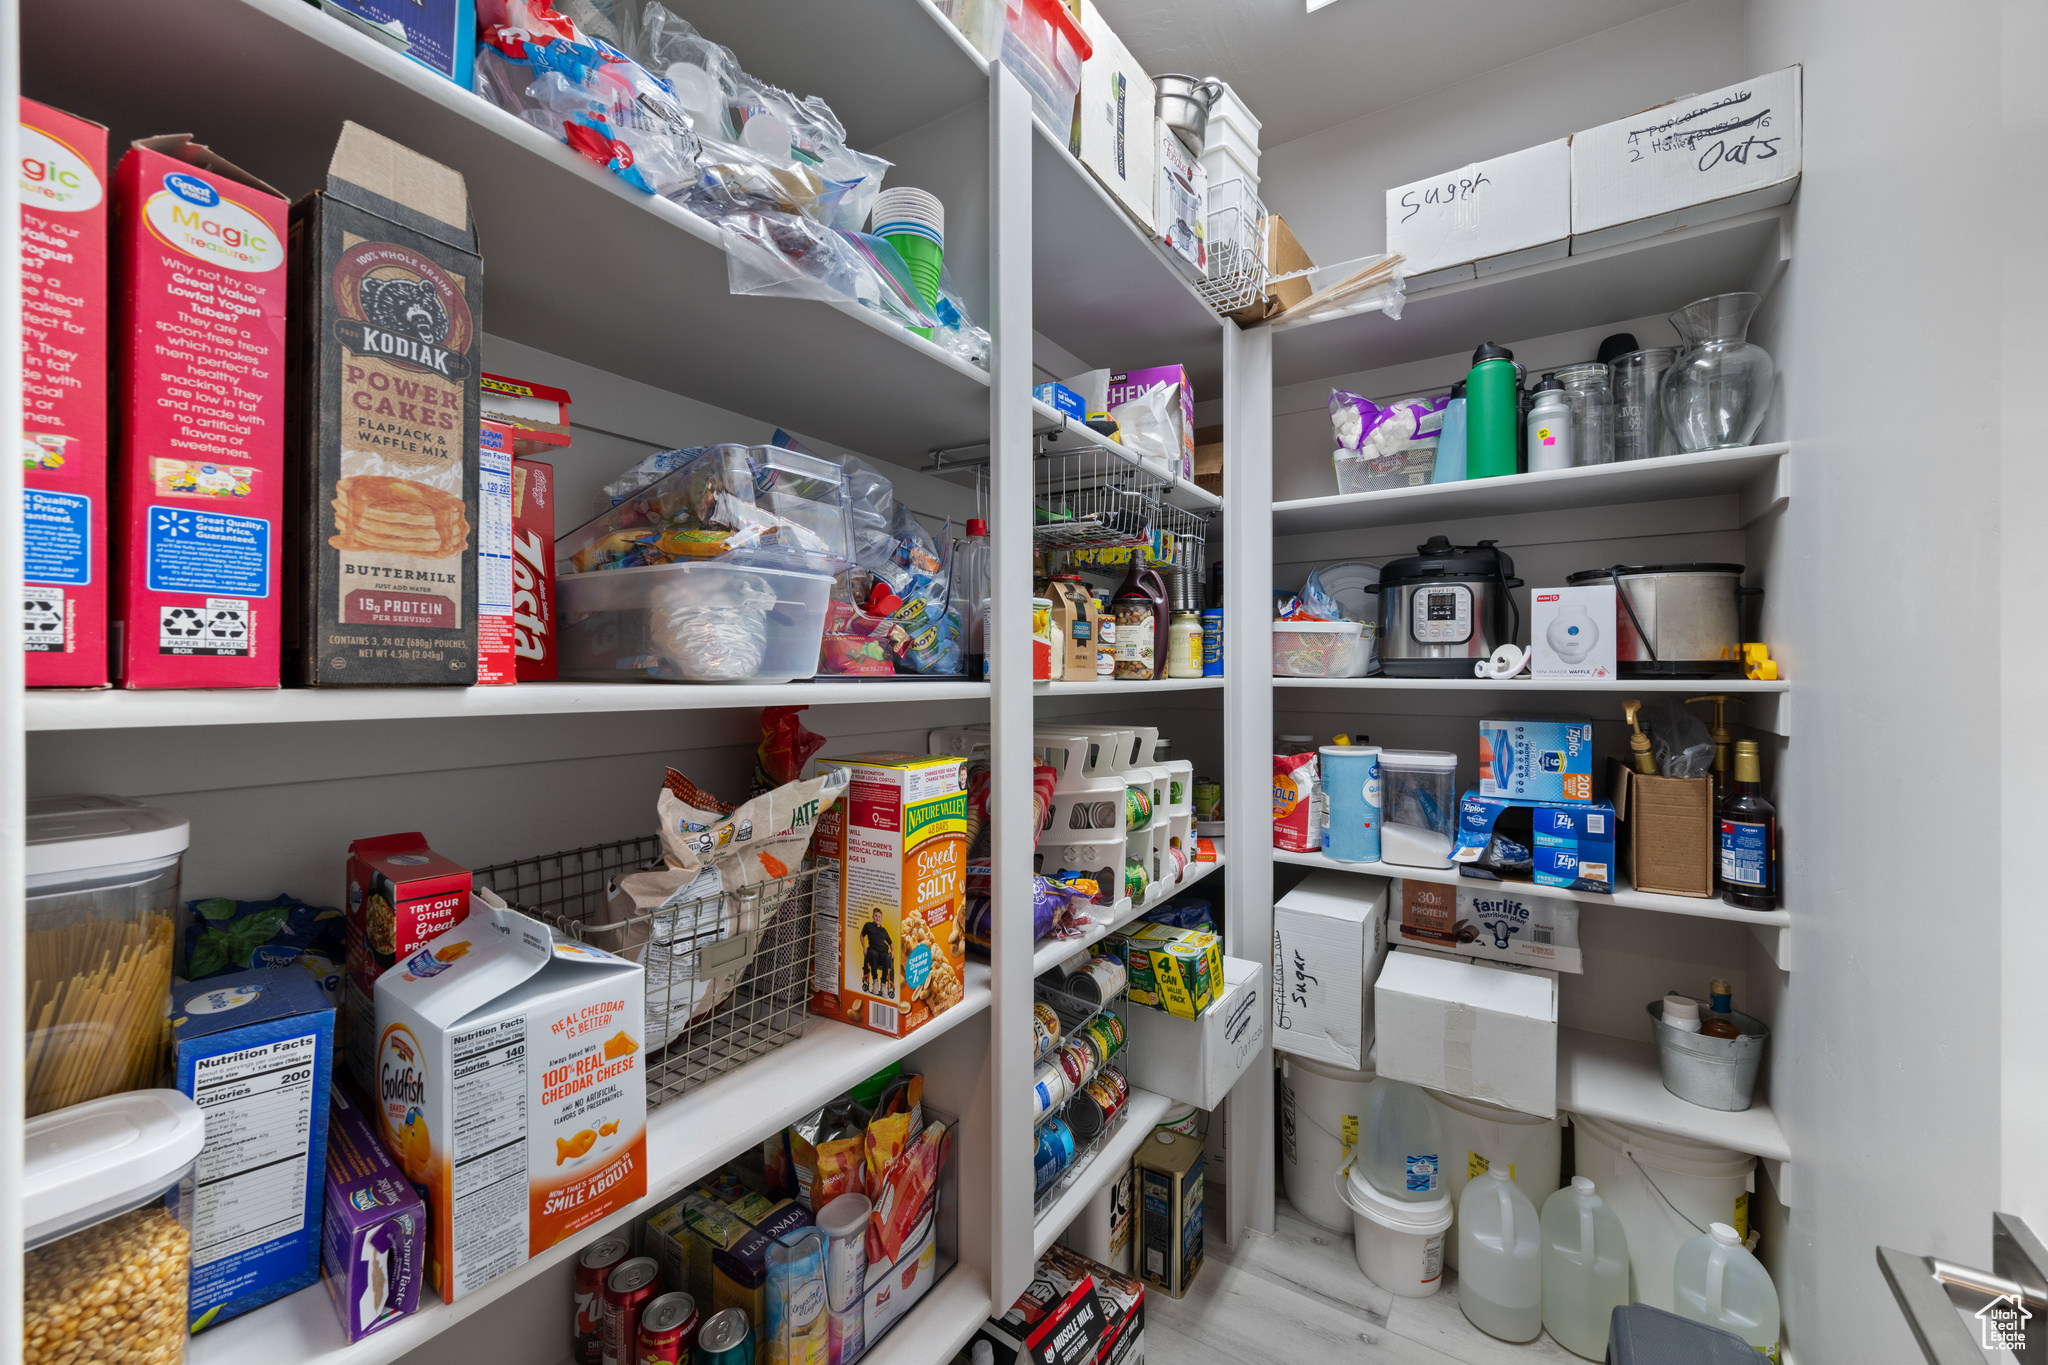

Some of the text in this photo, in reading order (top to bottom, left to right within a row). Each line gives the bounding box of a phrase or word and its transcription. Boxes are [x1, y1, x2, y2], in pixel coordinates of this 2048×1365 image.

[408, 27, 441, 49] CUTLERY
[1163, 138, 1187, 175] Fondue
[1628, 149, 1644, 163] 2
[1698, 135, 1782, 172] Oats
[22, 157, 81, 189] gic
[170, 176, 211, 199] Great
[24, 213, 80, 238] try our
[172, 204, 268, 253] Magic
[161, 256, 194, 274] Why
[356, 250, 454, 297] 100% WHOLE GRAINS
[43, 288, 85, 308] treat
[172, 272, 257, 304] Great Value
[167, 283, 262, 318] Lowfat Yogurt
[177, 310, 211, 330] They
[190, 302, 239, 324] Tubes?
[156, 320, 269, 355] spoon-free treat
[38, 342, 78, 362] They
[154, 344, 249, 374] them perfect
[167, 336, 260, 365] which makes
[362, 326, 450, 375] KODIAK
[188, 364, 240, 386] healthy
[160, 372, 263, 403] snacking. They
[196, 391, 221, 405] low
[346, 364, 459, 411] POWER
[157, 398, 235, 420] and made
[352, 391, 457, 430] CAKES
[181, 426, 228, 443] flavors
[196, 418, 251, 435] artificial
[358, 417, 447, 446] FLAPJACK &
[170, 438, 252, 460] sweeteners.
[358, 430, 448, 459] WAFFLE MIX
[494, 452, 511, 462] Facts
[32, 494, 84, 509] Quality.
[32, 503, 69, 514] Price.
[195, 523, 254, 536] Great Price.
[196, 515, 265, 531] Great Quality.
[195, 531, 258, 544] Guaranteed.
[345, 564, 456, 584] BUTTERMILK
[360, 598, 442, 615] 15g PROTEIN
[372, 614, 432, 624] PER SERVING
[208, 640, 246, 649] PLASTIC
[216, 648, 237, 656] BAG
[329, 635, 468, 650] CONTAINS (680g) POUCHES,
[358, 649, 374, 658] NET
[376, 650, 388, 658] WT
[1568, 728, 1582, 758] Ziploc
[1577, 774, 1590, 799] 200
[908, 798, 966, 833] NATURE VALLEY
[1464, 803, 1487, 814] Ziploc
[816, 824, 840, 836] SALTY
[849, 828, 862, 838] WILL
[928, 820, 949, 835] 48 BARS
[849, 838, 893, 852] DELL CHILDREN'S
[1536, 836, 1564, 844] FREEZER
[849, 846, 893, 858] MEDICAL CENTER
[917, 840, 958, 877] Sweet
[932, 868, 943, 876] AND
[1536, 875, 1564, 883] FREEZER
[917, 870, 956, 904] SALTY
[410, 898, 460, 915] TRY OUR
[1418, 892, 1442, 906] 30g
[417, 908, 452, 922] OTHER
[927, 903, 947, 918] Peanut
[1412, 906, 1448, 918] PROTEIN
[1478, 912, 1526, 926] nutrition plan
[416, 916, 456, 940] Great
[1158, 956, 1172, 974] 4
[1210, 948, 1217, 964] 4
[1161, 974, 1177, 986] CAN
[1292, 949, 1318, 1008] Sugar
[1166, 986, 1182, 996] VALUE
[1170, 994, 1186, 1004] PACK
[551, 1000, 625, 1036] REAL CHEDDAR
[566, 1014, 612, 1040] IS BETTER!
[454, 1018, 524, 1045] Nutrition Facts
[198, 1038, 314, 1071] Nutrition Facts
[454, 1044, 525, 1077] Calories 140
[198, 1071, 239, 1085] Serving size
[541, 1052, 605, 1090] 100% REAL
[542, 1056, 634, 1106] CHEDDAR CHEESE
[196, 1069, 311, 1106] Calories 200
[382, 1062, 426, 1106] Goldfish
[586, 1084, 618, 1104] ARTIFICIAL
[554, 1090, 624, 1126] FLAVORS PRESERVATIVES.
[548, 1152, 630, 1198] NOW THAT'S SOMETHING TO
[542, 1189, 585, 1216] SMILE
[588, 1158, 634, 1200] ABOUT!
[742, 1208, 807, 1257] LEMONADE
[395, 1238, 413, 1306] Smart Taste
[1053, 1318, 1080, 1353] MUSCLE
[1076, 1302, 1094, 1328] MILK
[640, 1334, 654, 1346] Cherry
